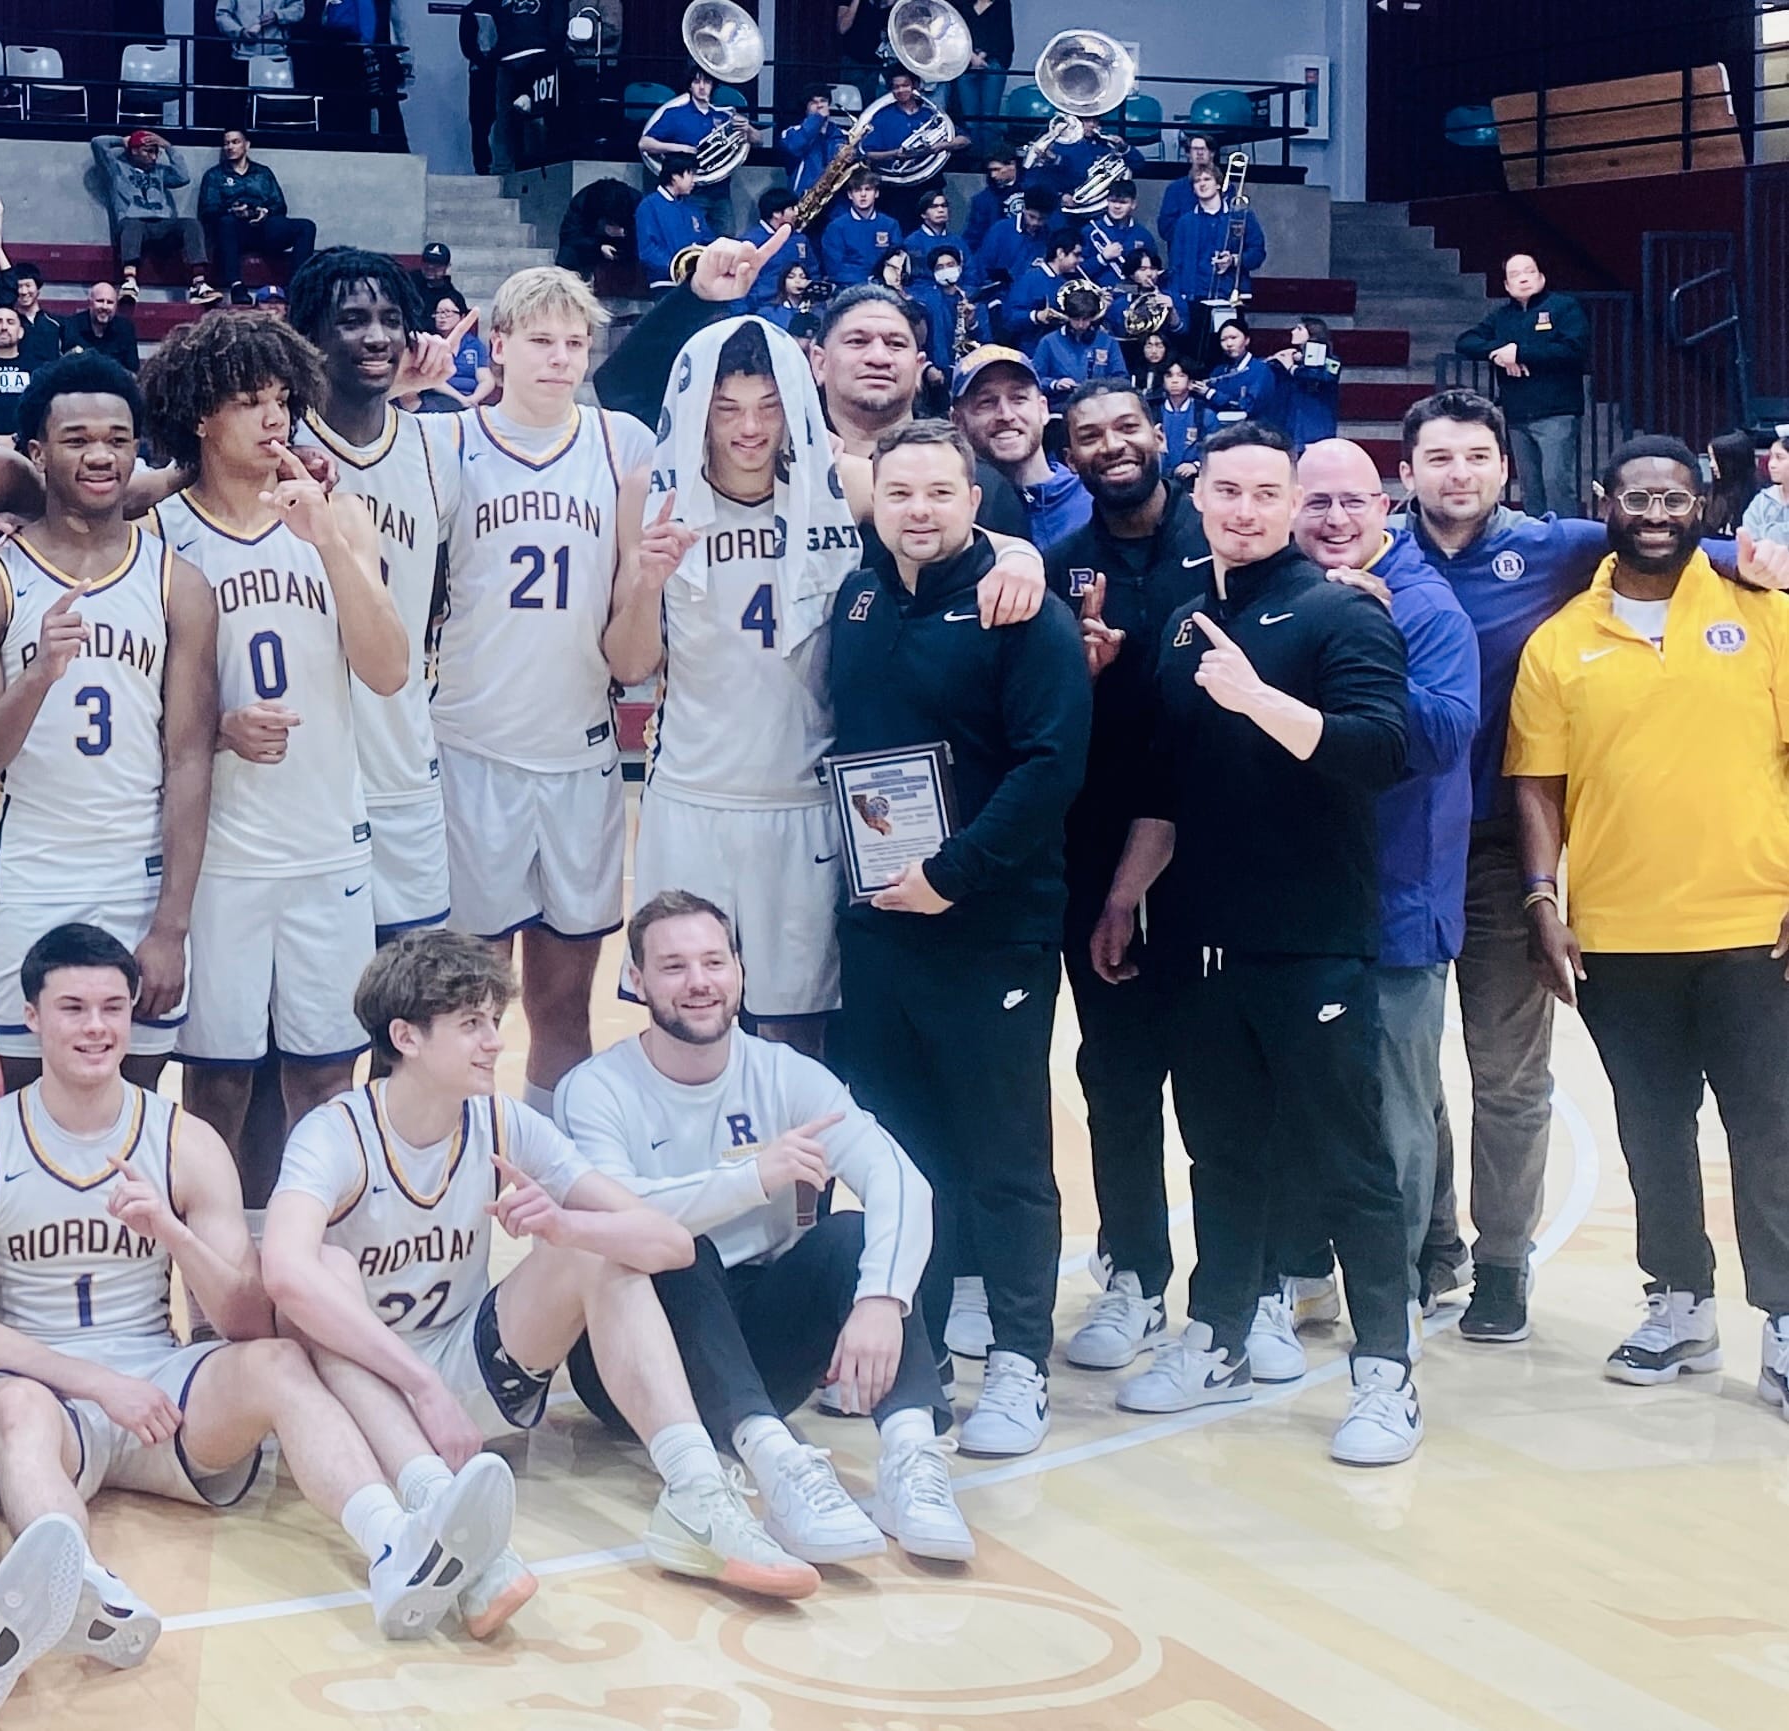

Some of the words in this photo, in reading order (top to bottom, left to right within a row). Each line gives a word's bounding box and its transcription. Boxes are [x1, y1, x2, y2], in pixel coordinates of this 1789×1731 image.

[532, 74, 555, 103] 107
[475, 490, 601, 540] RIORDAN
[707, 526, 776, 568] IORD
[212, 568, 327, 615] ORDAN
[510, 545, 570, 610] 21
[740, 583, 778, 649] 4
[21, 622, 156, 677] RDAN
[249, 630, 288, 700] 0
[75, 686, 113, 757] 3
[726, 1113, 758, 1147] R
[8, 1218, 156, 1263] RIORDAN
[74, 1272, 94, 1328] 1
